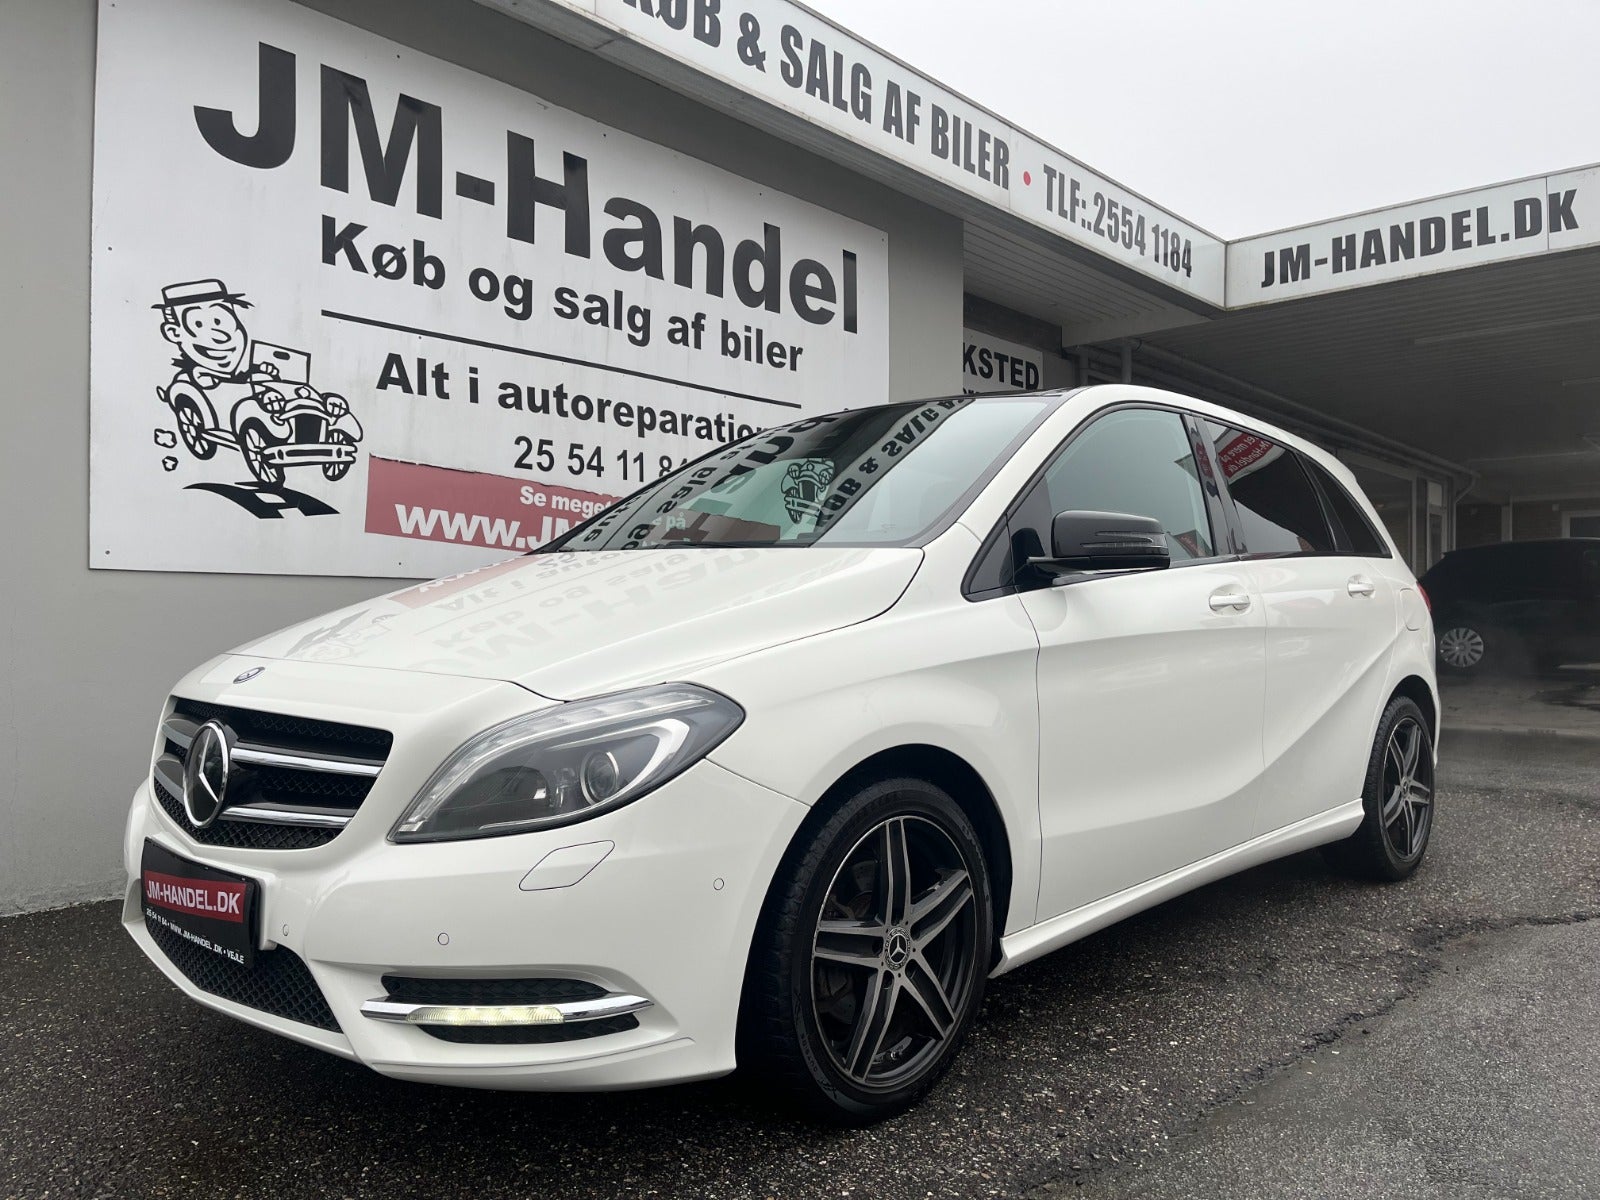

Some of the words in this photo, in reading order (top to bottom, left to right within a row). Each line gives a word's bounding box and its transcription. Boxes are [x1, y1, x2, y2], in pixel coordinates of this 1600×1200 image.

[622, 0, 721, 48] ØB
[737, 12, 766, 73] &
[780, 24, 872, 124] SALG
[883, 79, 921, 145] AF
[931, 103, 1010, 190] BILER
[1152, 224, 1192, 278] 1184
[193, 41, 858, 334] JM-Handel
[1261, 189, 1580, 288] JM-HANDEL.DK
[321, 214, 446, 289] Køb
[469, 266, 533, 321] og
[553, 286, 651, 347] salg
[667, 311, 706, 351] af
[721, 320, 804, 372] biler
[376, 352, 449, 400] Alt
[468, 366, 480, 403] i
[963, 342, 1040, 390] KSTED
[514, 435, 555, 472] 25
[567, 441, 605, 478] 54
[616, 449, 644, 483] 11
[519, 485, 547, 507] Se
[146, 880, 241, 914] JM-HANDEL.DK
